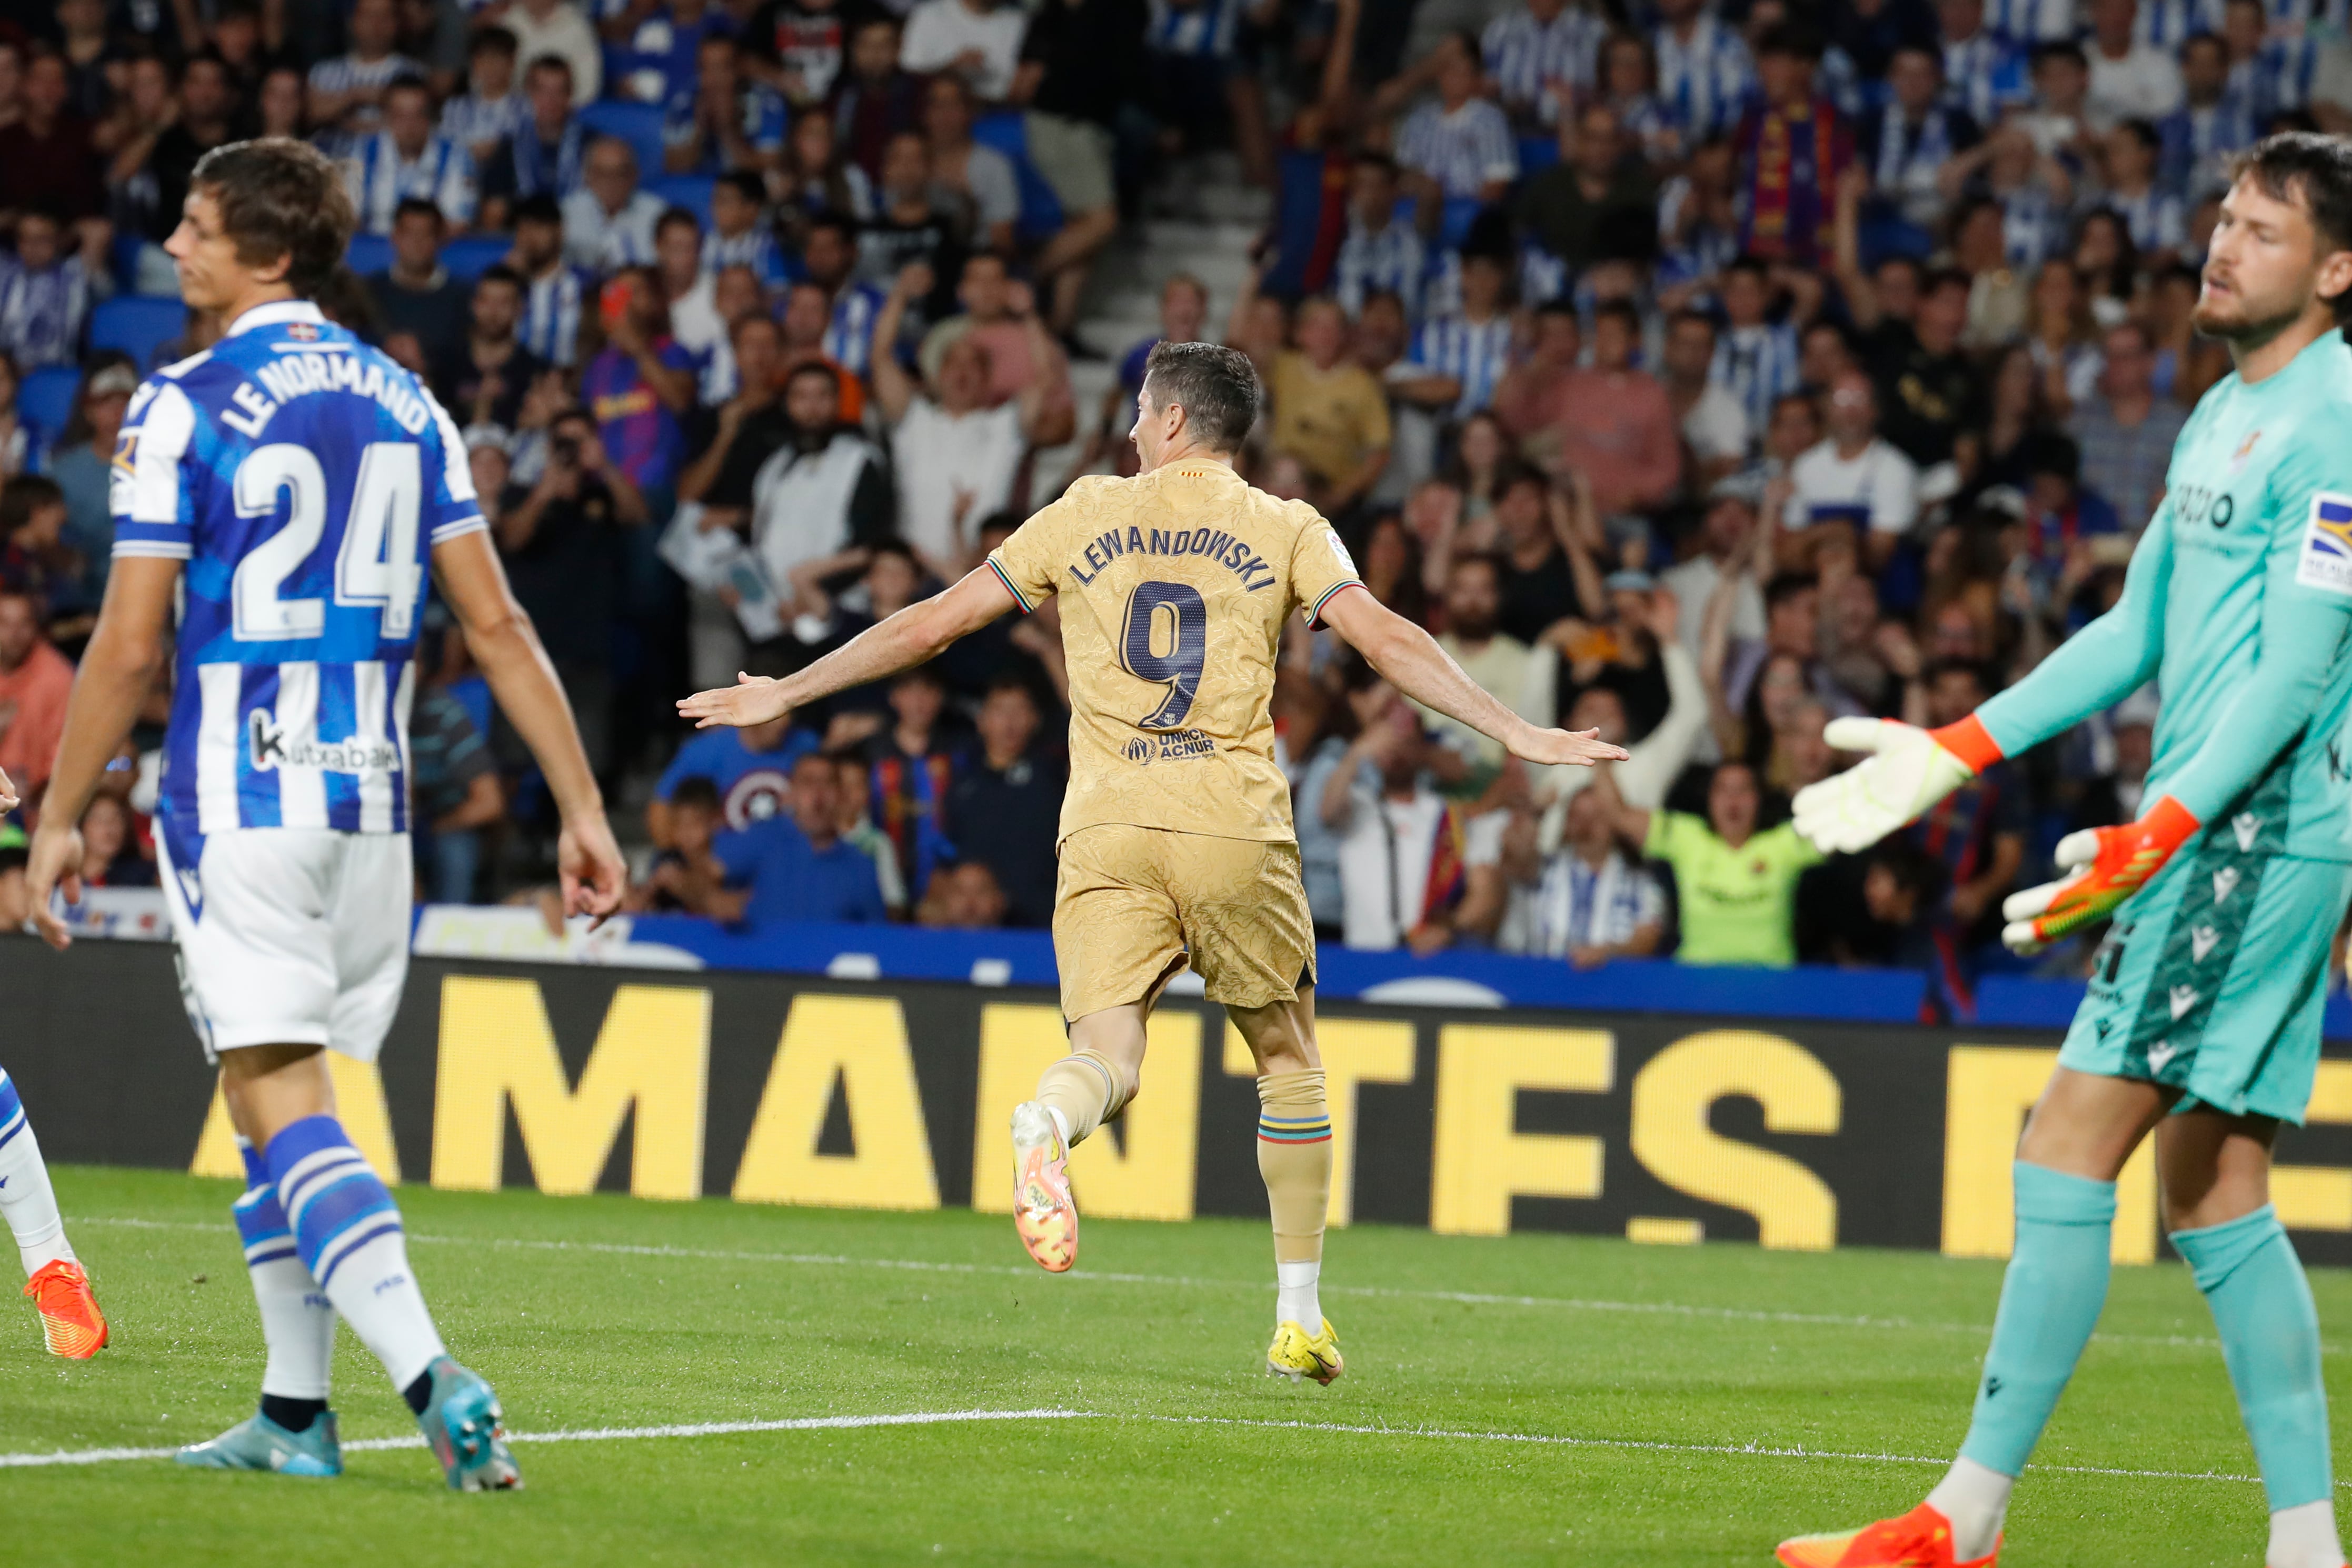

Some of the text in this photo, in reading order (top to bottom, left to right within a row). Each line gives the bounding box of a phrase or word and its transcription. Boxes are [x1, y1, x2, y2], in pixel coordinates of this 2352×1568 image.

[220, 353, 431, 439] LE NORMAND
[232, 442, 423, 642] 24
[1069, 526, 1275, 592] LEWANDOWSKI
[1119, 581, 1206, 727] 9
[1161, 740, 1214, 758] ACNUR
